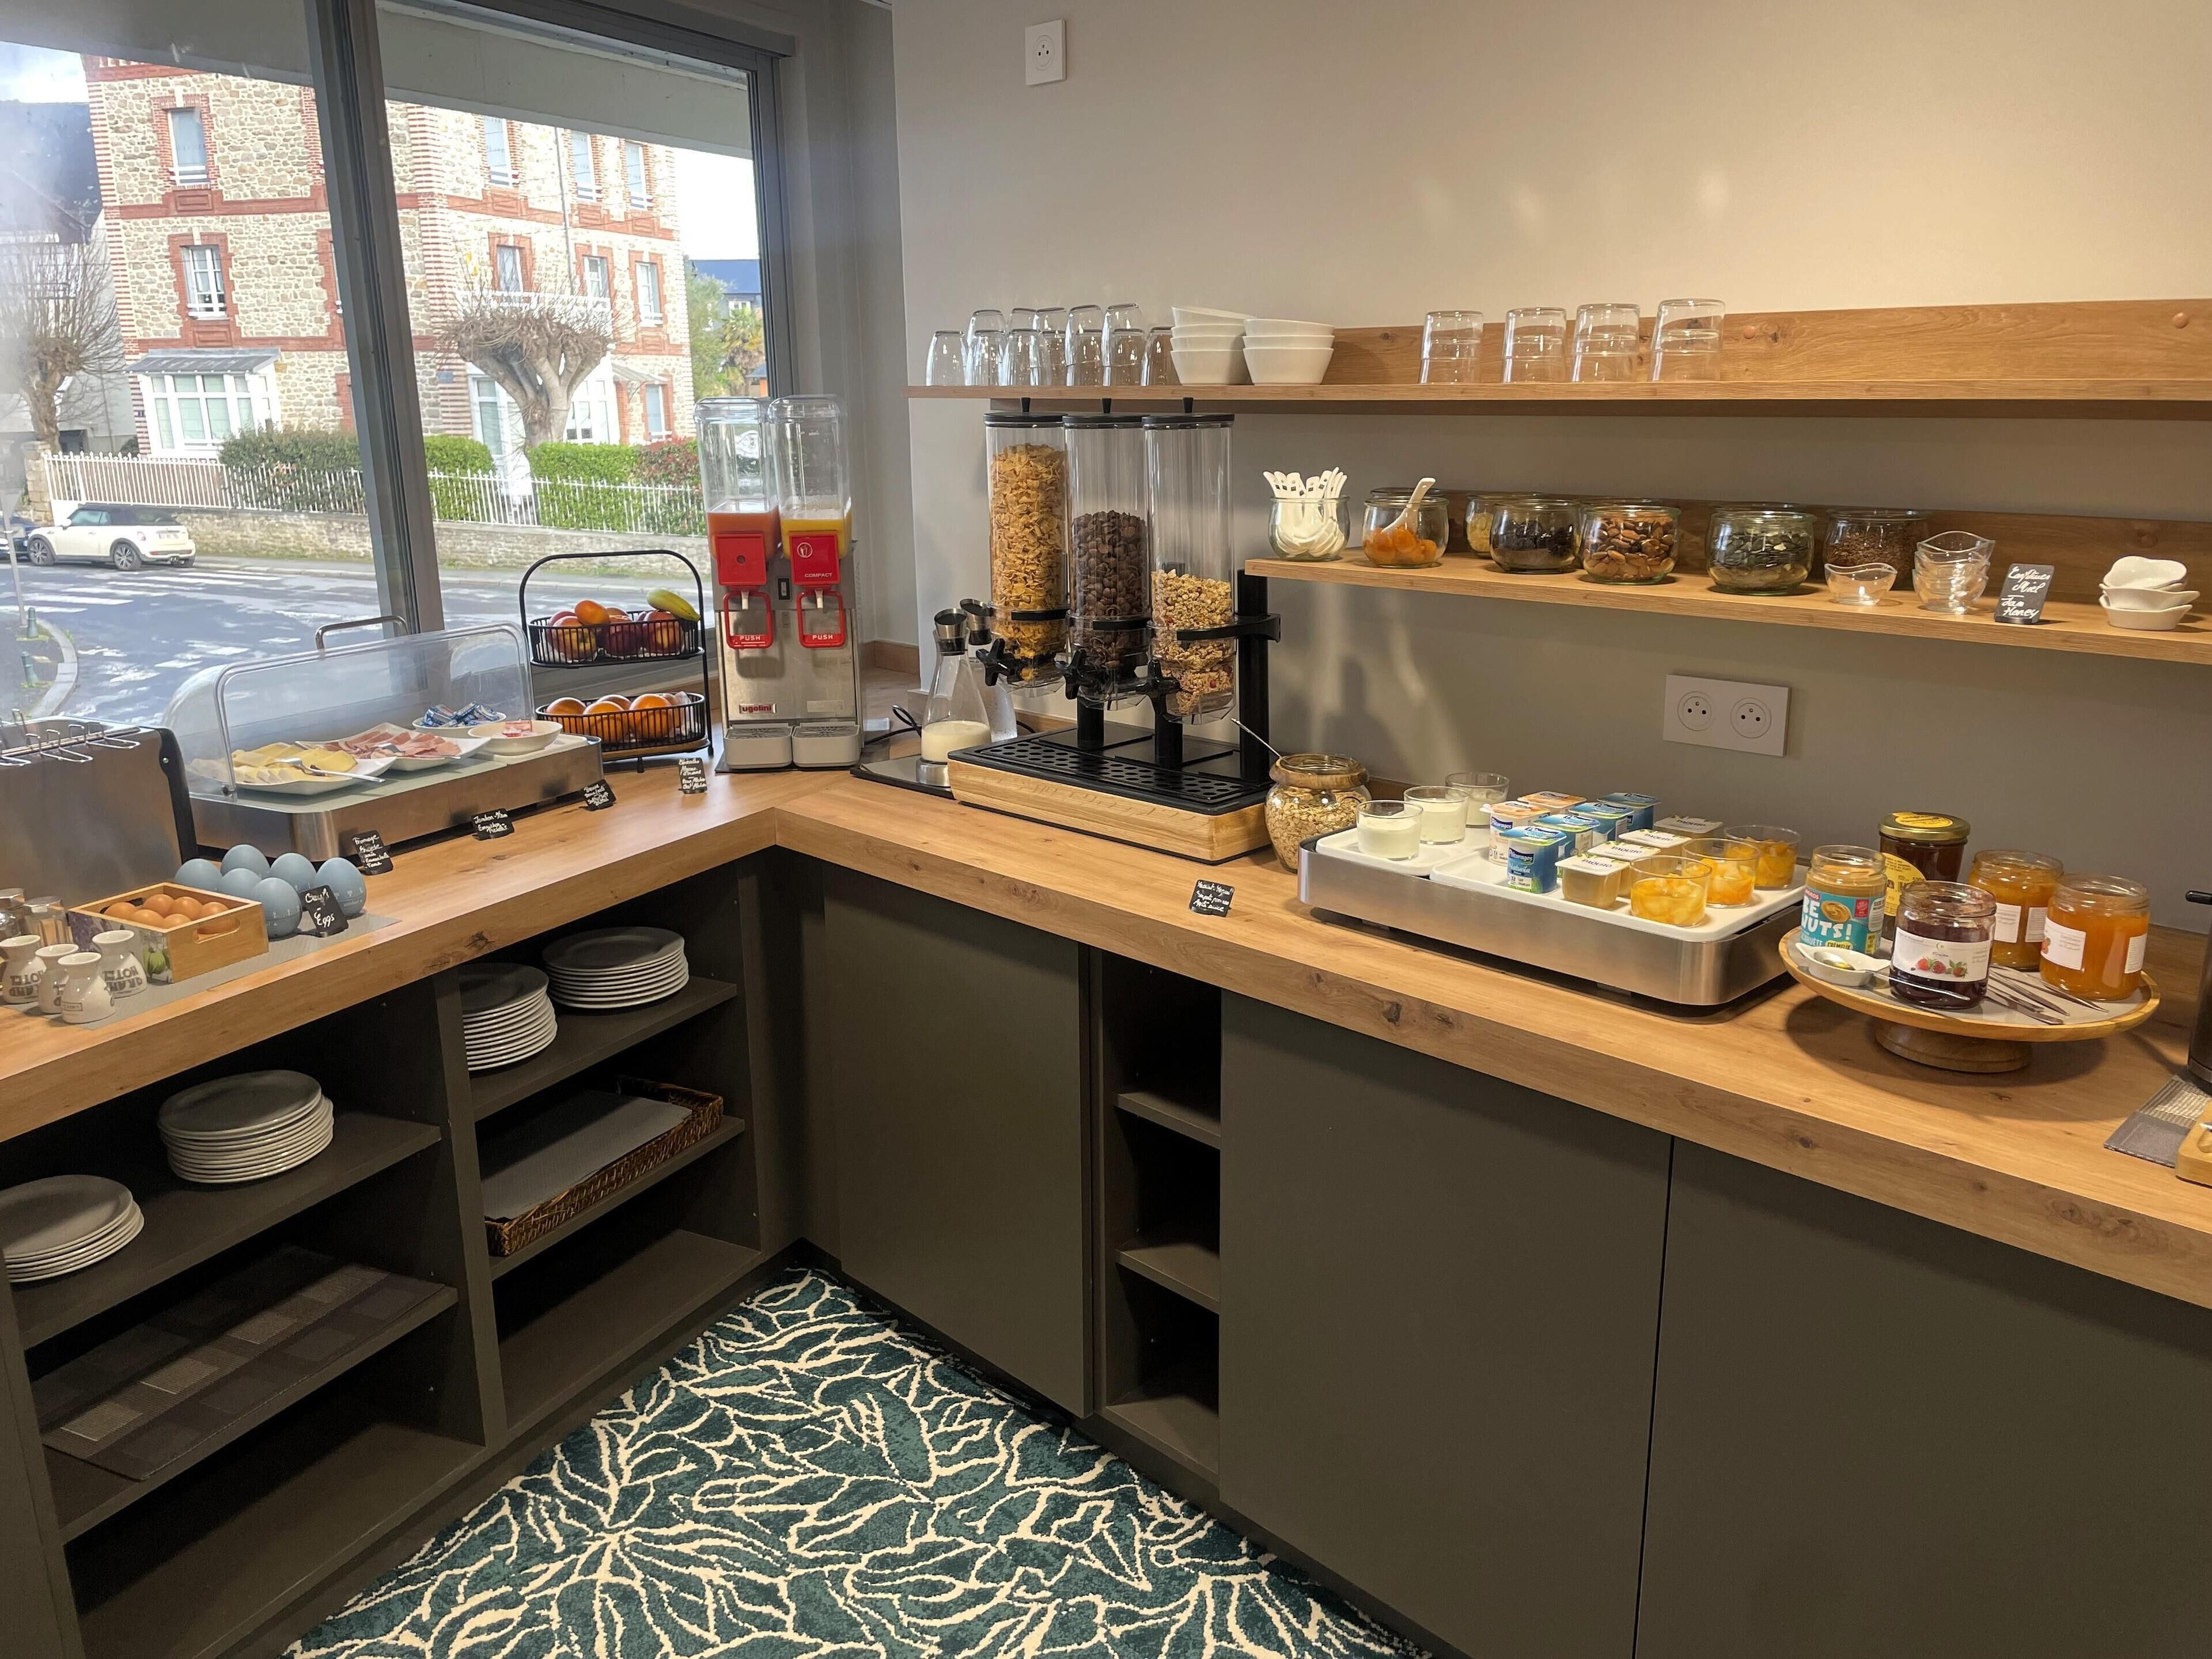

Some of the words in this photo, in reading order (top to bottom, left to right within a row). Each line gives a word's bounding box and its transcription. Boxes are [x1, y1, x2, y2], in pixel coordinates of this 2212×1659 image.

[2012, 581, 2046, 593] Miel
[2001, 597, 2024, 607] Jam
[2002, 607, 2039, 619] Honey
[742, 704, 772, 713] ugolini
[1611, 845, 1642, 854] PAQUITO
[1581, 858, 1612, 868] PAQUITO
[314, 911, 335, 928] Eggs
[1802, 914, 1853, 941] NUTS!
